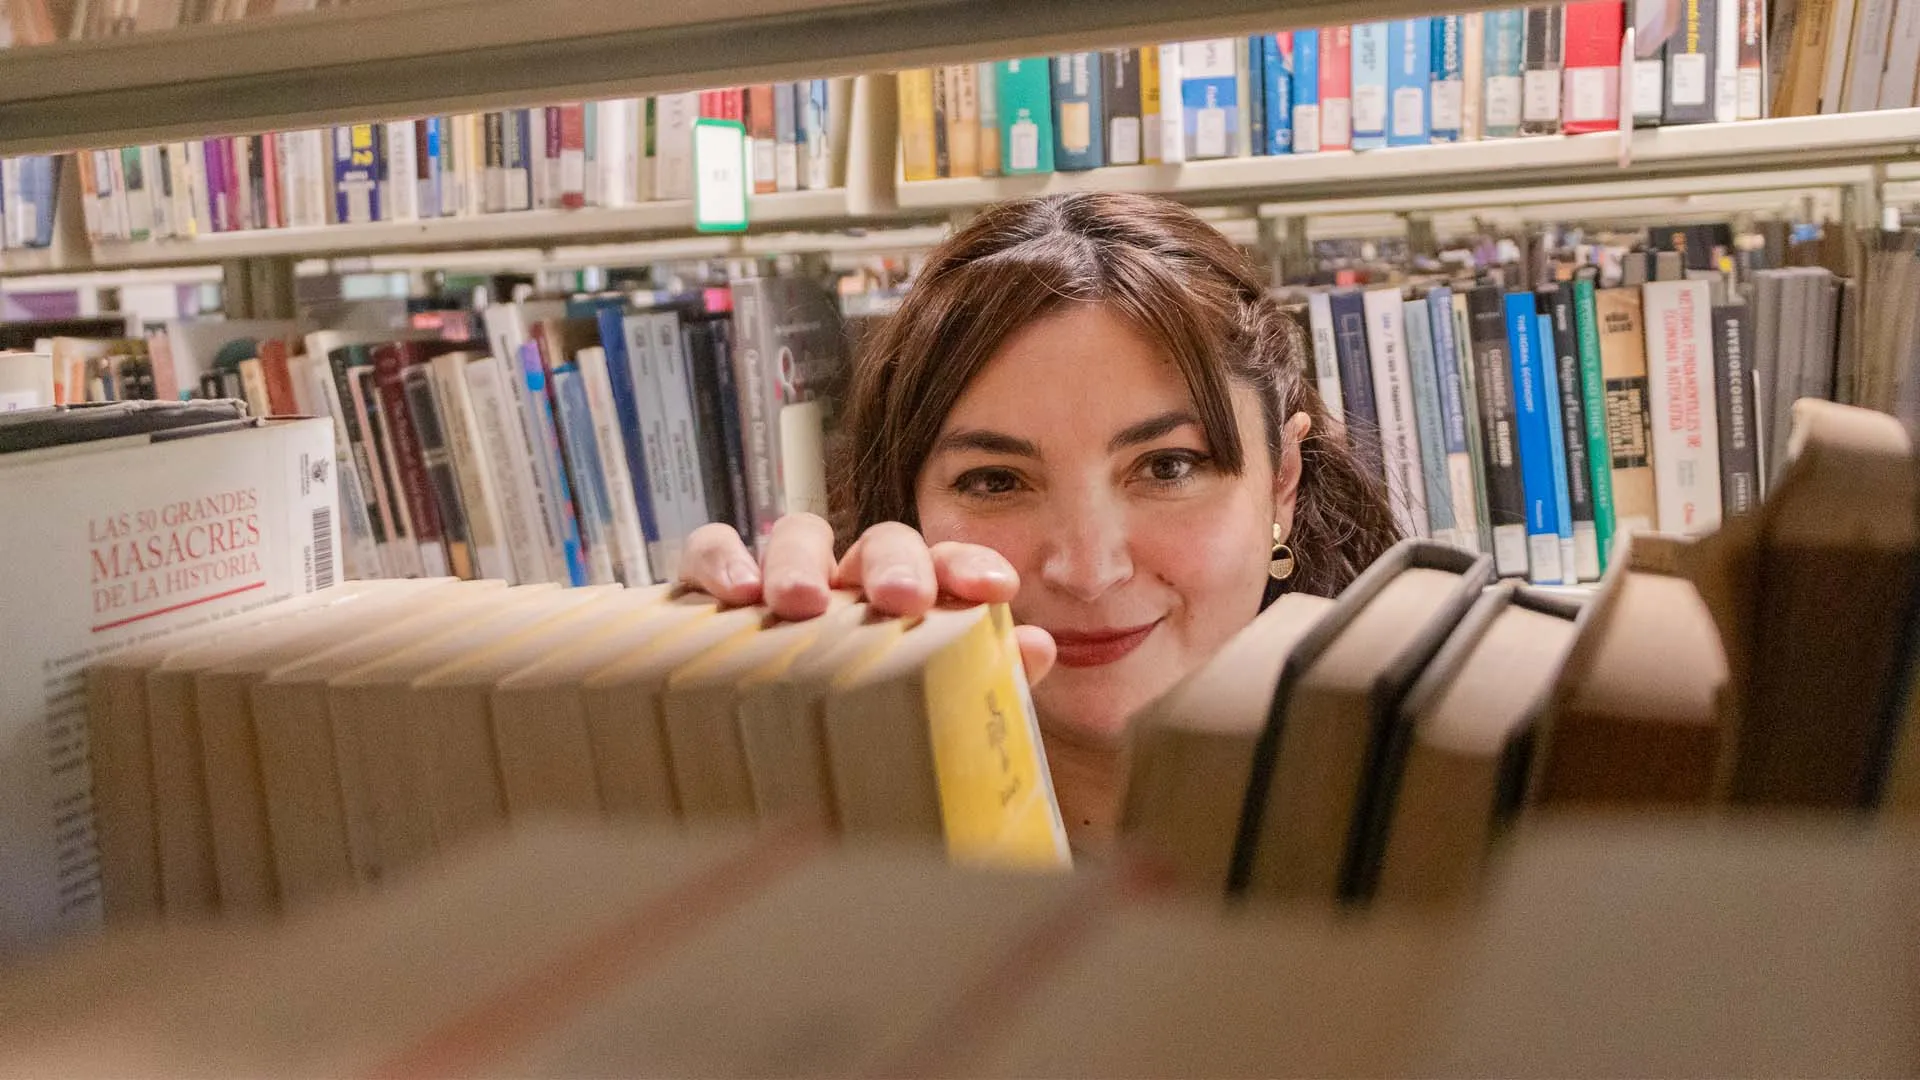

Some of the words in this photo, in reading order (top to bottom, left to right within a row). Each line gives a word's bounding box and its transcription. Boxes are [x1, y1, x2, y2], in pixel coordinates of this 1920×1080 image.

[1560, 355, 1576, 393] Origins
[1726, 319, 1746, 449] PHYSIOECONOMICS
[1564, 393, 1579, 407] of
[1566, 406, 1580, 429] Law
[752, 421, 766, 457] Data
[1567, 429, 1583, 450] and
[88, 512, 130, 543] LAS
[137, 508, 158, 533] 50
[162, 488, 258, 526] GRANDES
[90, 513, 260, 585] MASACRES
[92, 583, 127, 613] DE
[130, 575, 160, 603] LA
[165, 551, 262, 595] HISTORIA
